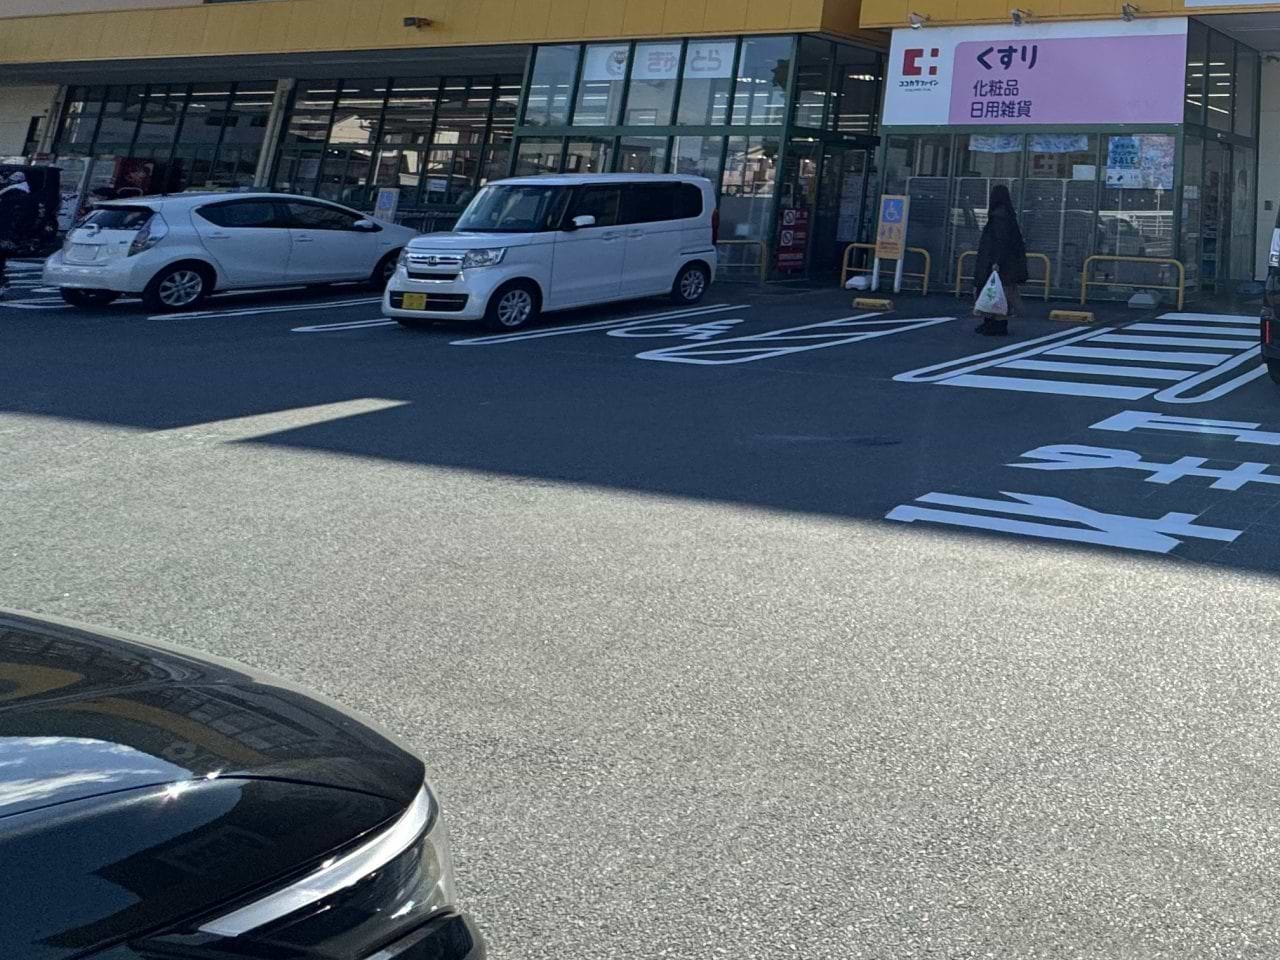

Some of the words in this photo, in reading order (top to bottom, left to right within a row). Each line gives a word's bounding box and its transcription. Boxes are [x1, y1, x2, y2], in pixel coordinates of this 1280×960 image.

[976, 44, 1038, 71] くすり
[898, 79, 939, 88] ココカラファイン
[972, 79, 1020, 98] 化粧品
[969, 100, 1033, 119] 日用雑貨
[1111, 156, 1137, 165] SALE
